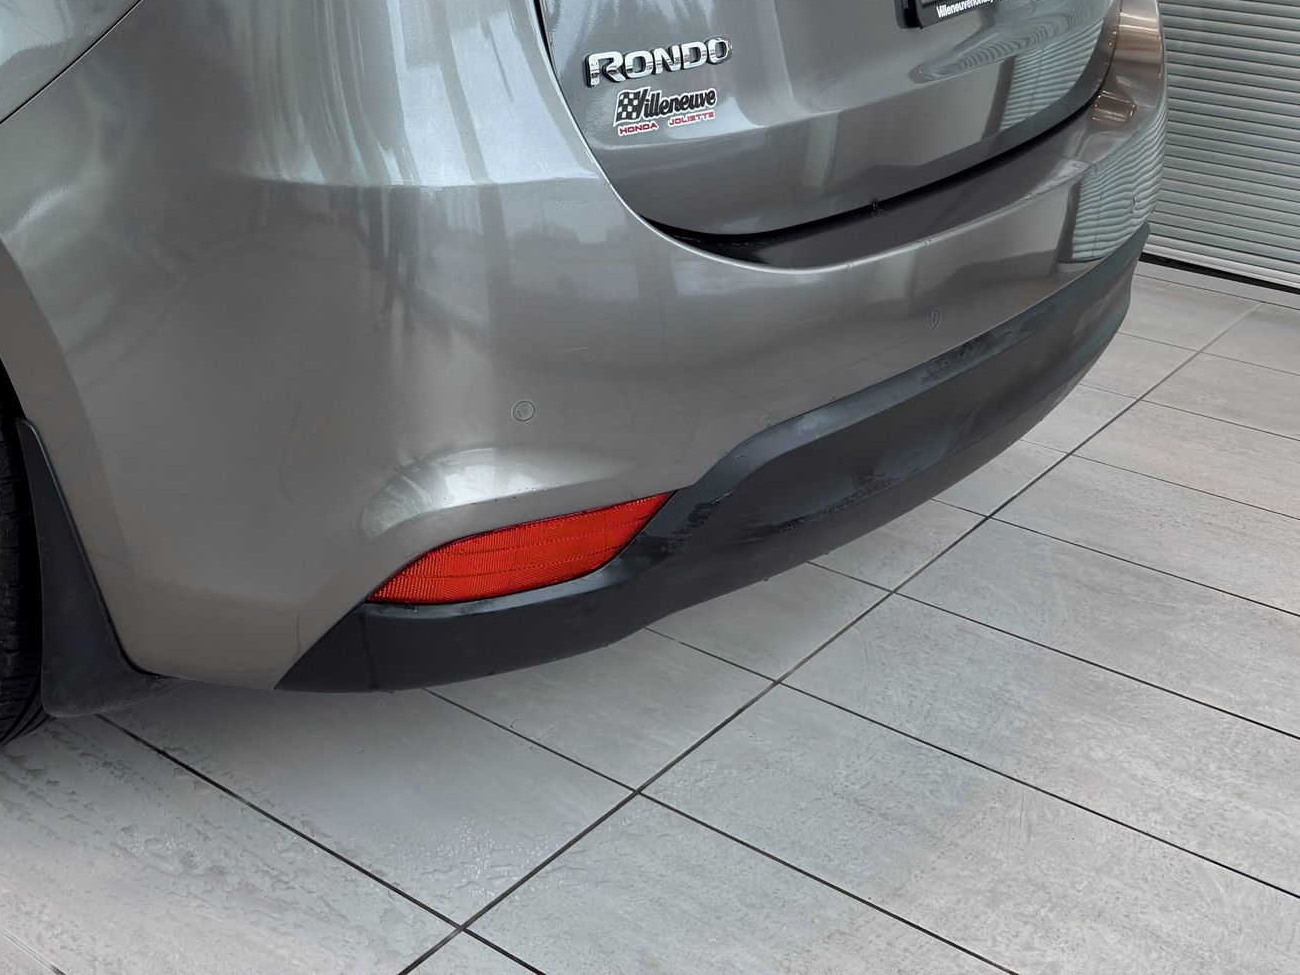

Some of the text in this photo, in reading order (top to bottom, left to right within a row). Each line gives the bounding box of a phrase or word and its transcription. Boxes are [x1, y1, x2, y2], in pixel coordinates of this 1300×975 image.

[584, 36, 733, 88] RONDO
[618, 110, 715, 135] HONDA JOLIETTE
